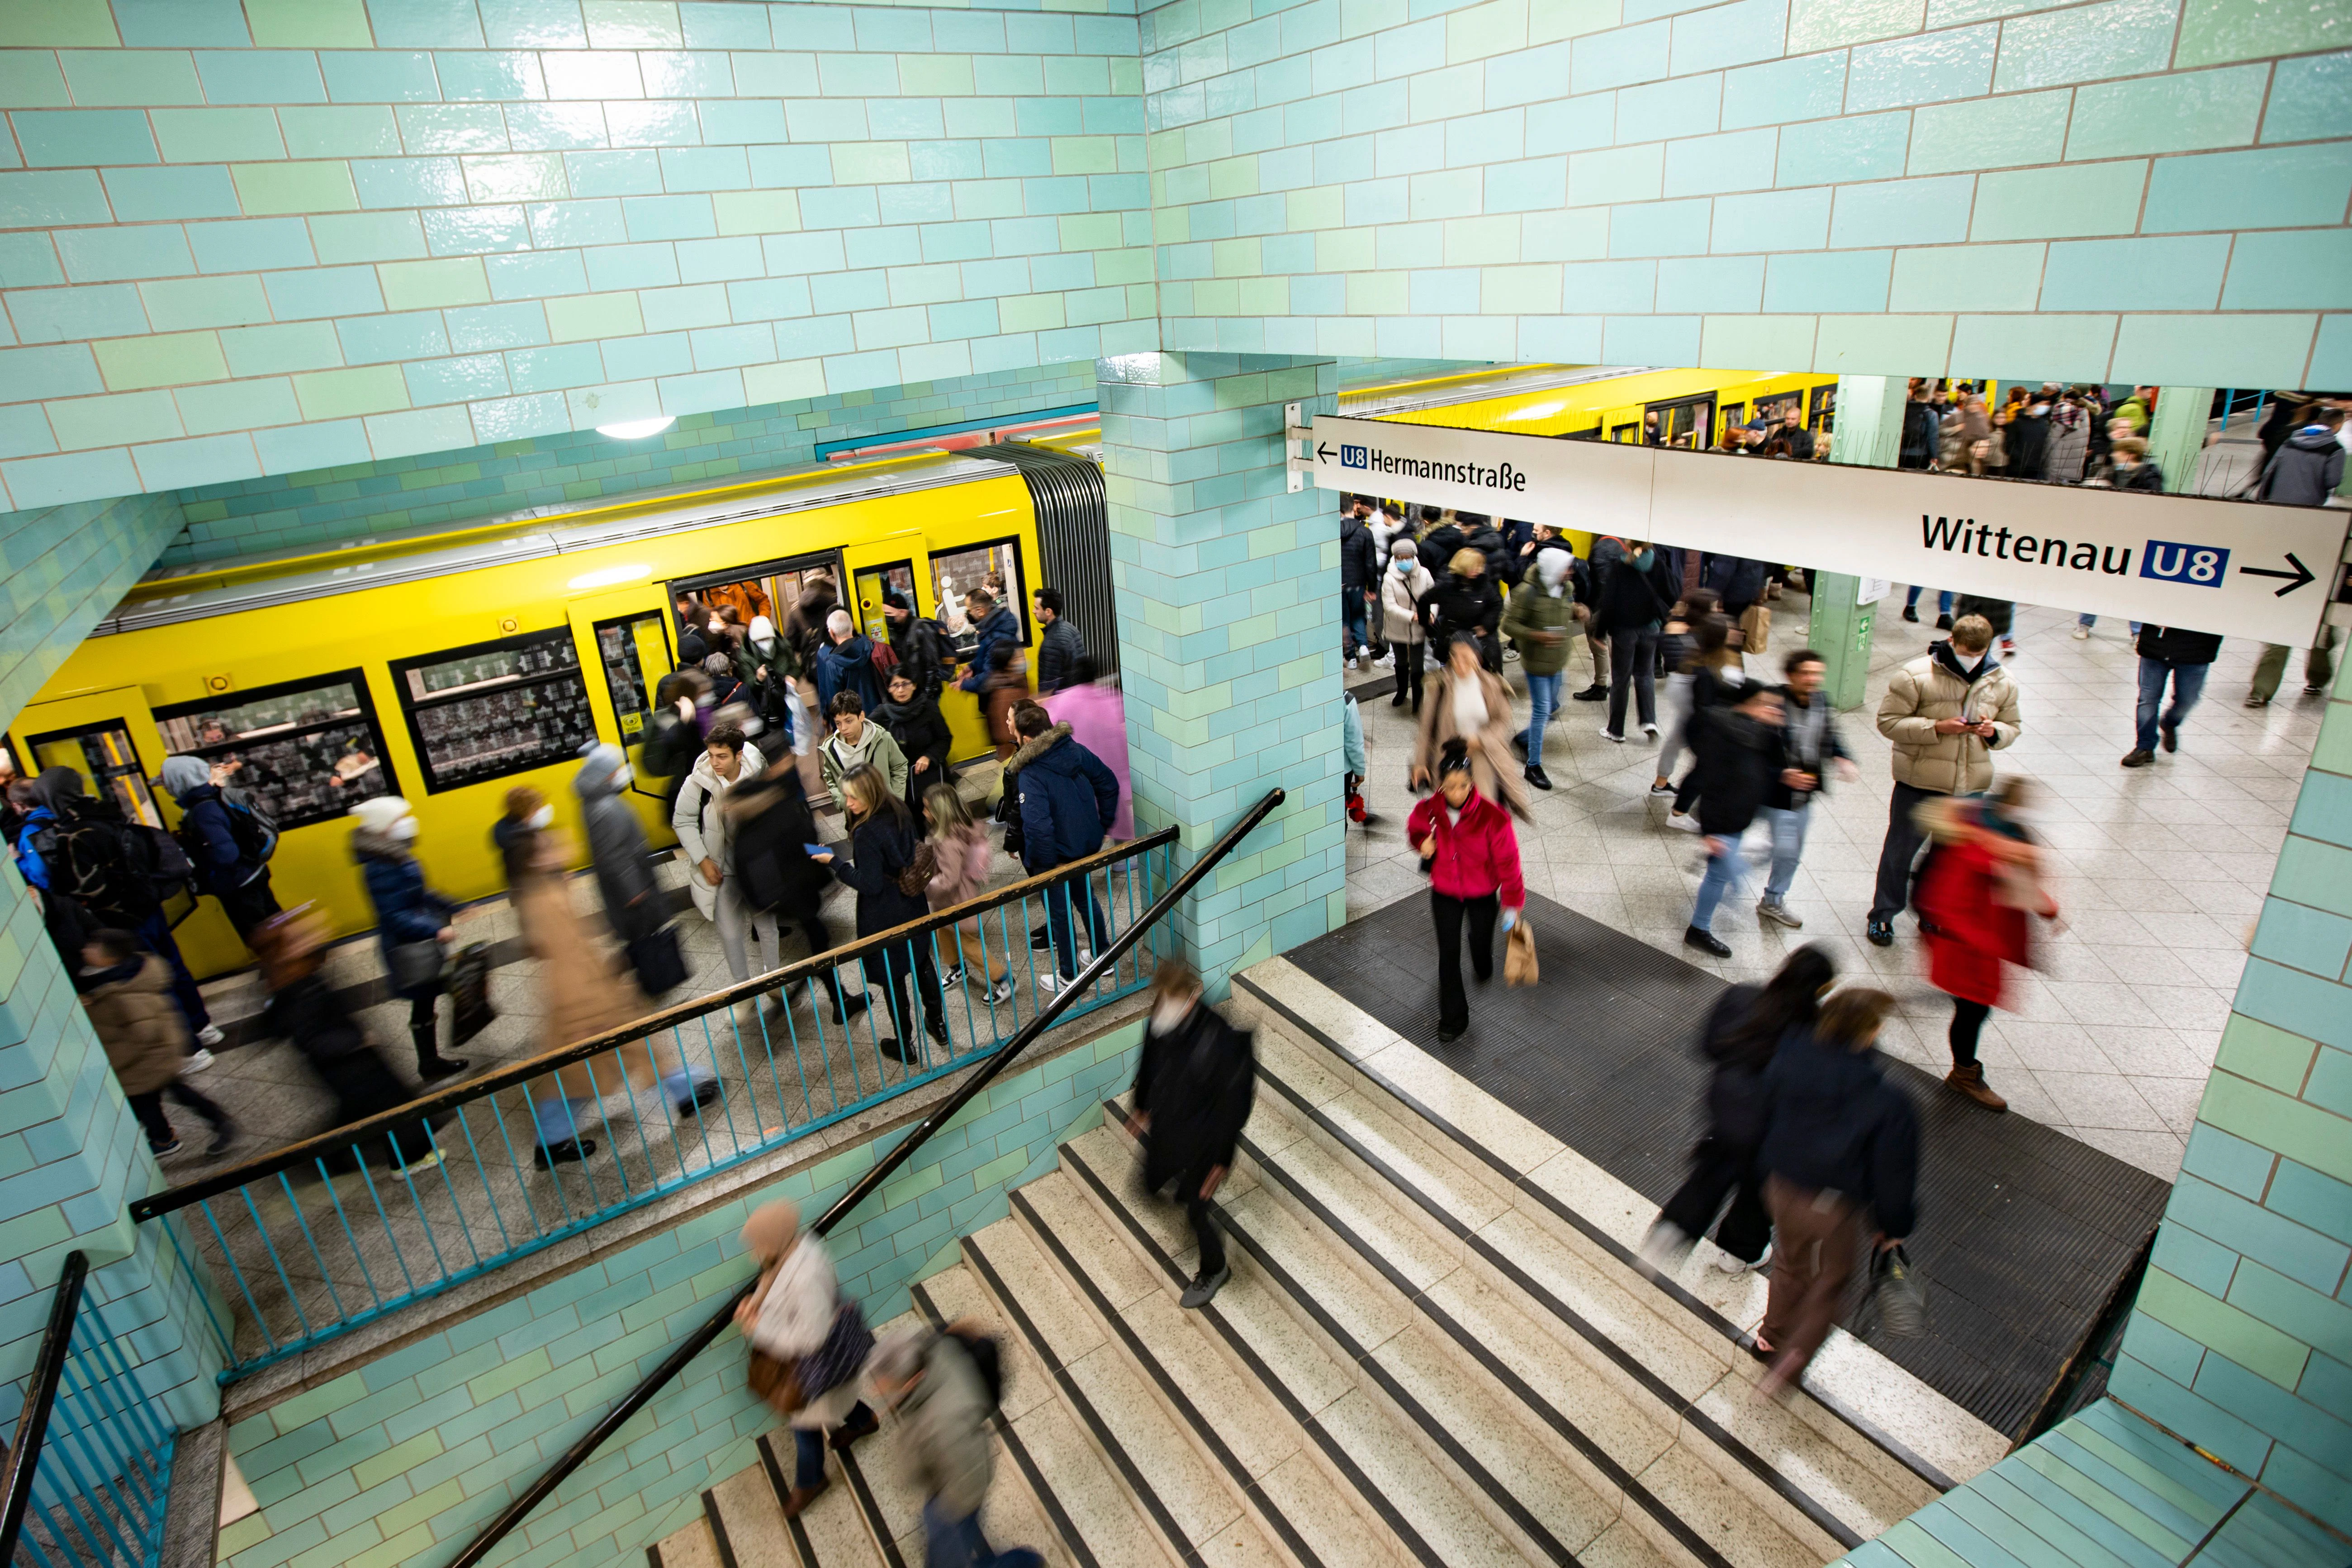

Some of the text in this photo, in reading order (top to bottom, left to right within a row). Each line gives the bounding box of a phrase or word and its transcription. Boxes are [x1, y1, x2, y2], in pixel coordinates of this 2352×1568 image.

[1344, 447, 1526, 492] U8 Hermannstraße
[1922, 514, 2218, 582] Wittenau U8
